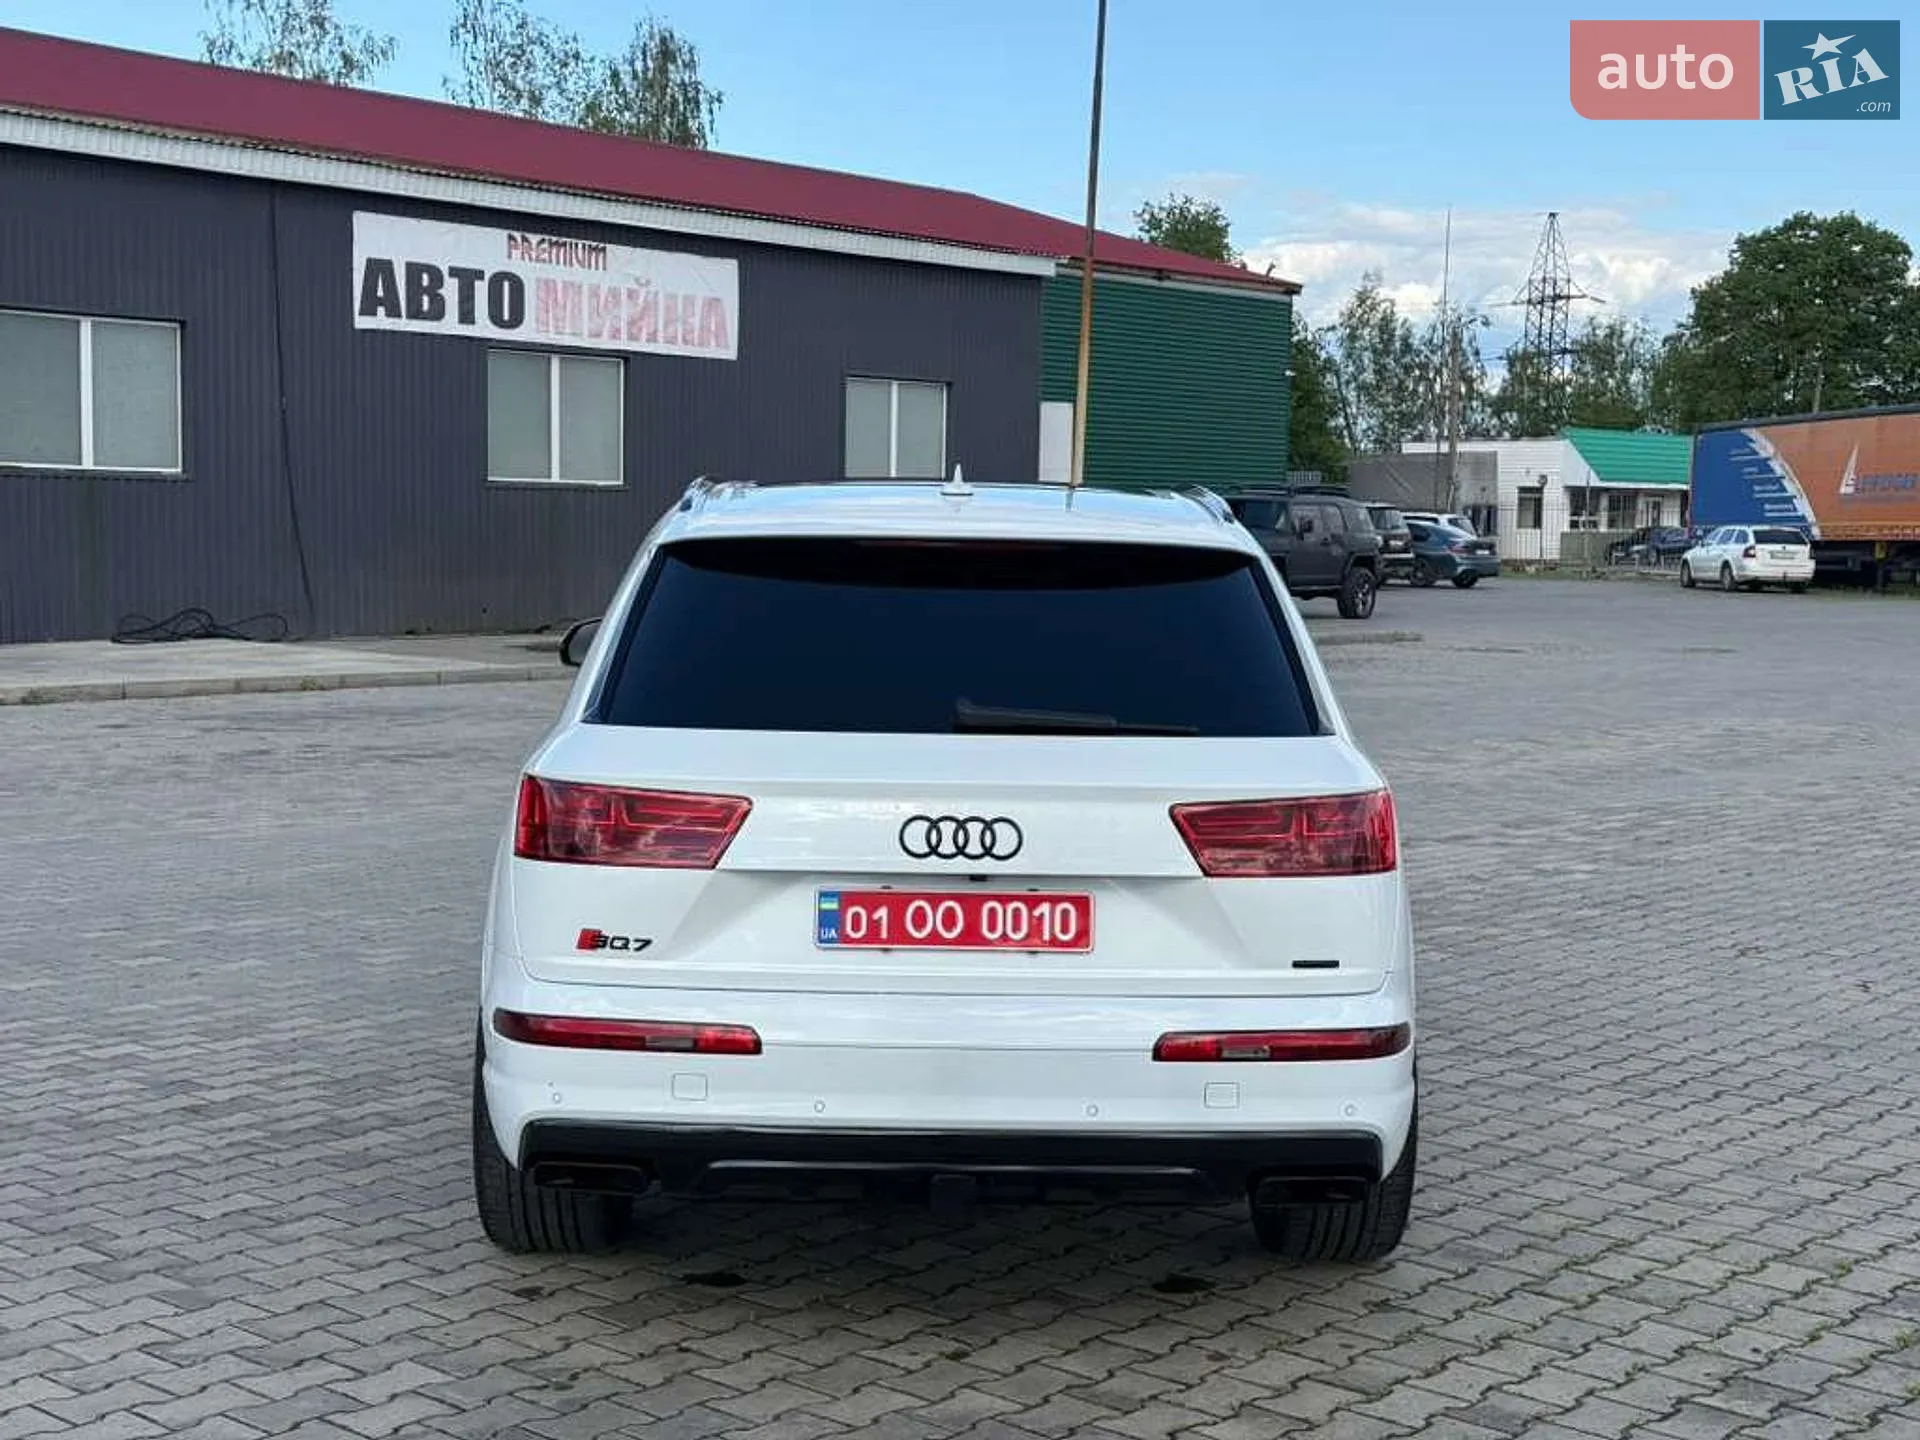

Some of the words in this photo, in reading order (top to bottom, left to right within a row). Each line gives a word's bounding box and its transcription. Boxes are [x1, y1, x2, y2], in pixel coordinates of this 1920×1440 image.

[507, 233, 607, 271] PREMIUM
[821, 930, 837, 939] UA
[846, 906, 889, 939] 01
[982, 901, 1077, 941] 0010
